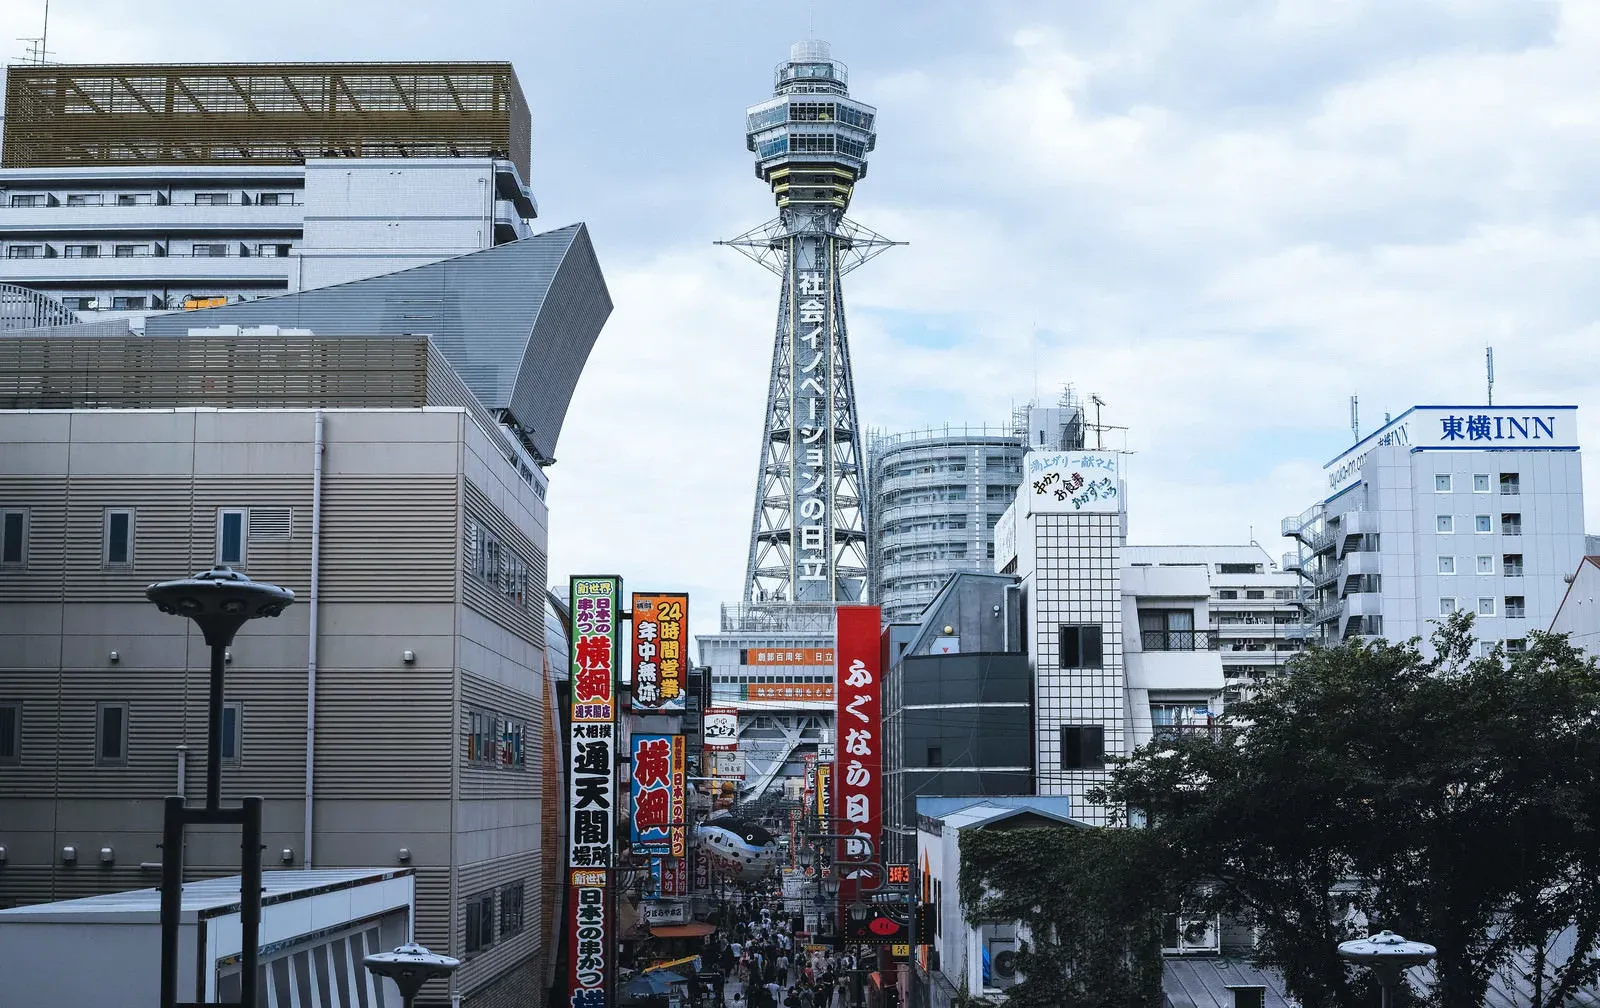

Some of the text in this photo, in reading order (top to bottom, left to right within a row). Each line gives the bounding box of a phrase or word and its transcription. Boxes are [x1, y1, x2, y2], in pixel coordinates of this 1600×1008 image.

[799, 271, 827, 581] 社会イノベーションの日立
[1439, 415, 1555, 441] 東横INN
[1054, 472, 1084, 502] お食事
[577, 582, 612, 595] 新世界
[575, 636, 611, 701] 横綱
[637, 621, 658, 702] 年中無休
[657, 602, 682, 698] 24時間営業
[573, 724, 612, 739] 大相撲
[574, 741, 611, 845] 通天閣
[635, 740, 671, 834] 横綱
[673, 773, 684, 854] 日本一の串かつ
[572, 845, 611, 867] 場所
[577, 888, 604, 986] 日本一の串かつ
